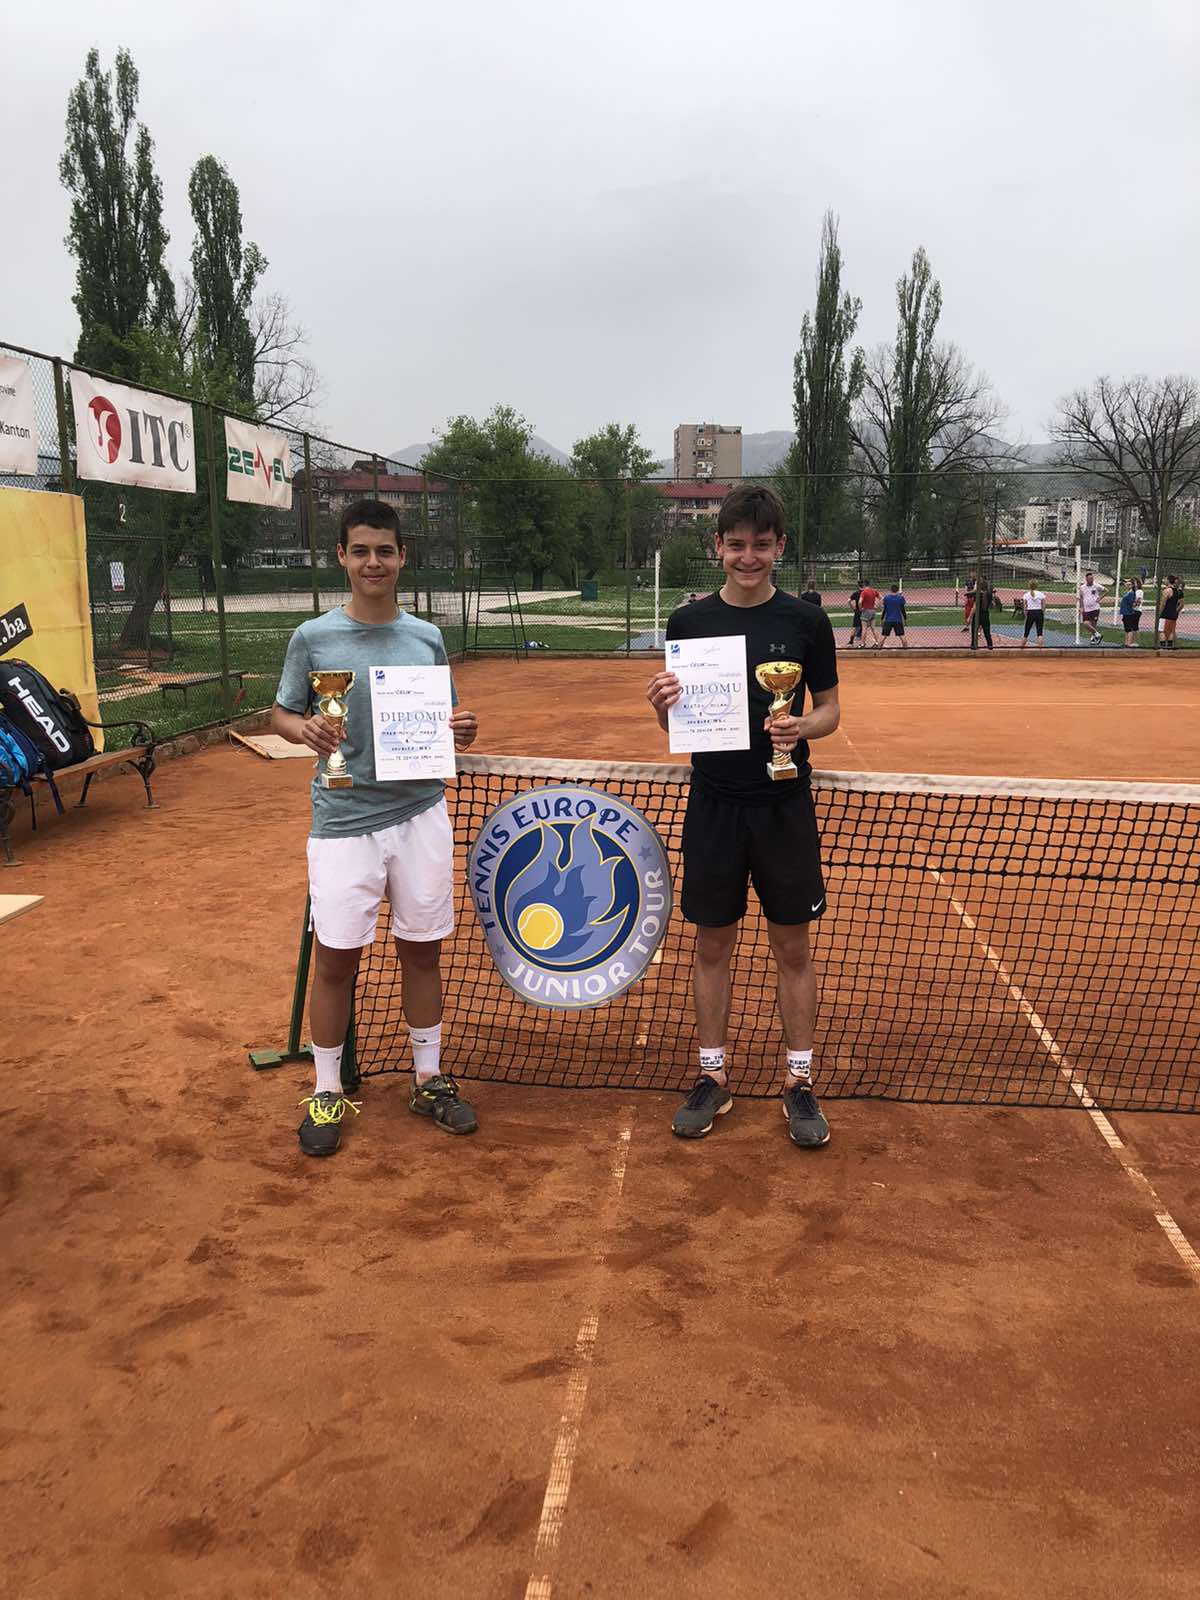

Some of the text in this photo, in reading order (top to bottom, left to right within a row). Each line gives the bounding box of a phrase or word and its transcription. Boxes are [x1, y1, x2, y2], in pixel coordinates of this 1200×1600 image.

[0, 617, 27, 646] .ba
[8, 676, 71, 753] HEAD
[380, 711, 447, 722] DIPLOMU
[475, 797, 640, 936] TENNIS EUROPE
[507, 867, 665, 999] JUNIOR TOUR
